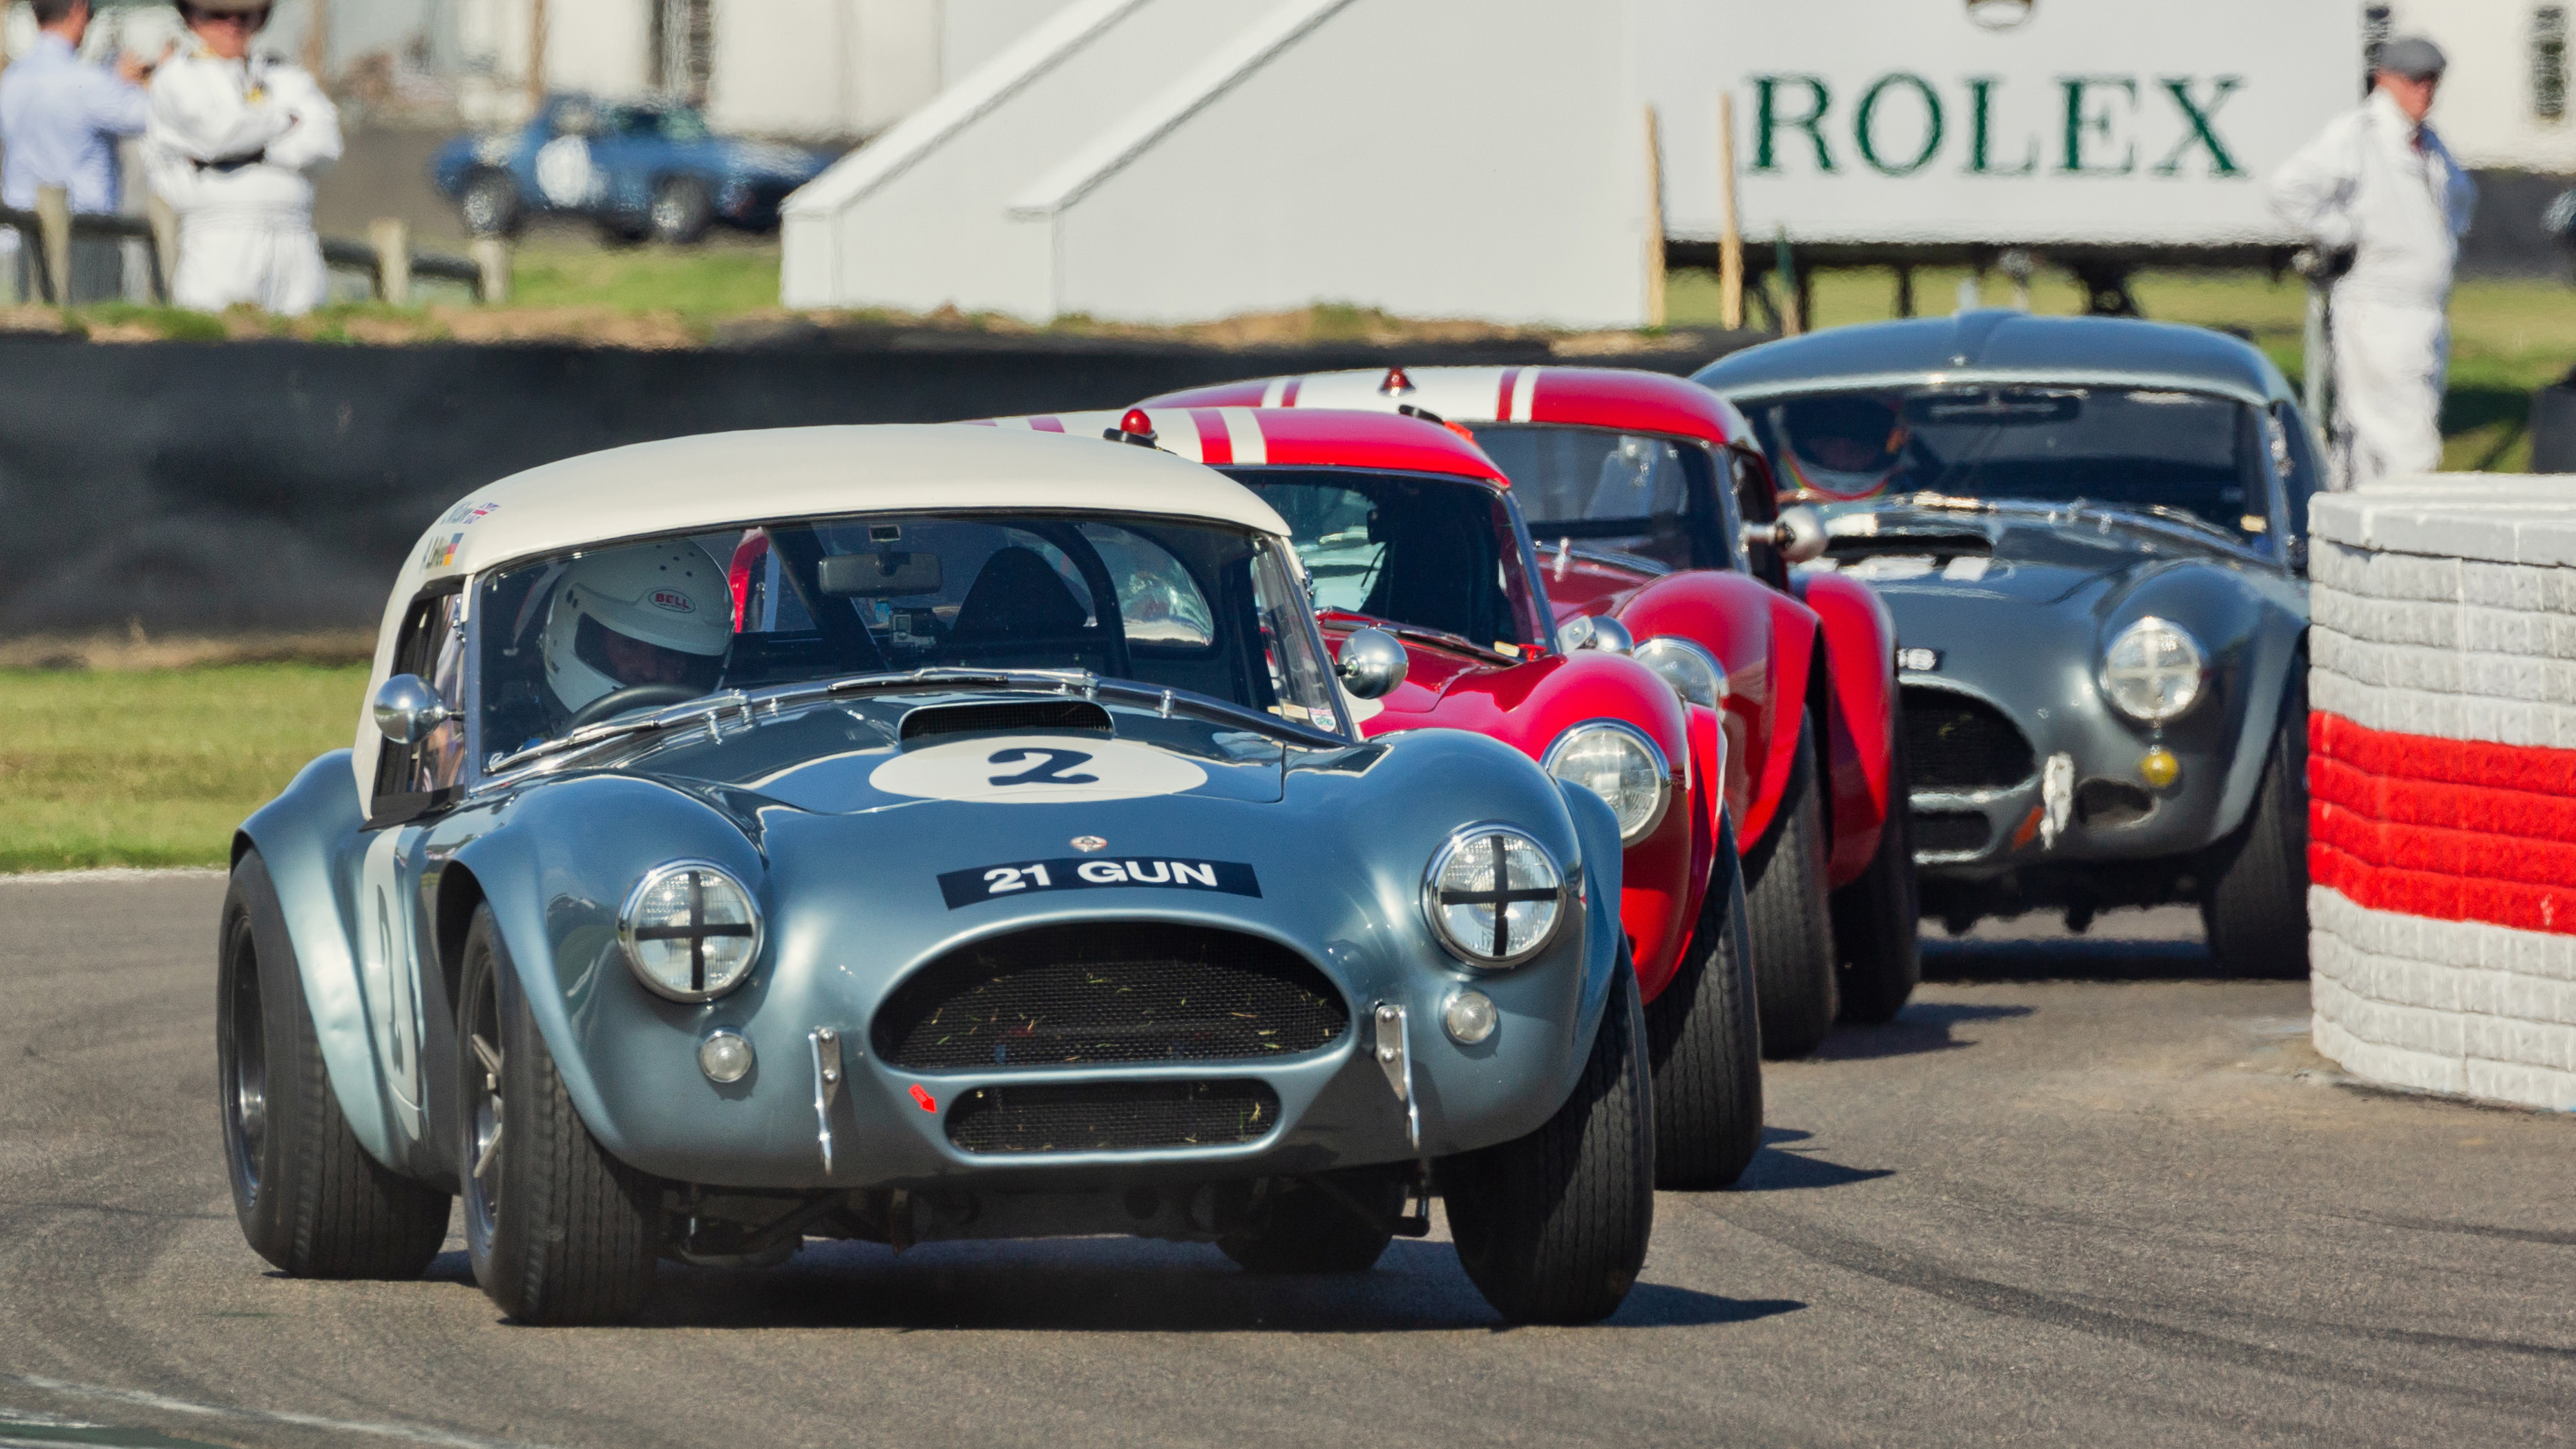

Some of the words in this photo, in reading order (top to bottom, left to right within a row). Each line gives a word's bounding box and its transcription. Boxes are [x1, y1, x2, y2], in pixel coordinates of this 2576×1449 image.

[1744, 71, 2251, 177] ROLEX
[655, 593, 689, 609] BELL
[987, 747, 1100, 787] 2
[984, 863, 1051, 894] 21
[1077, 861, 1218, 887] GUN
